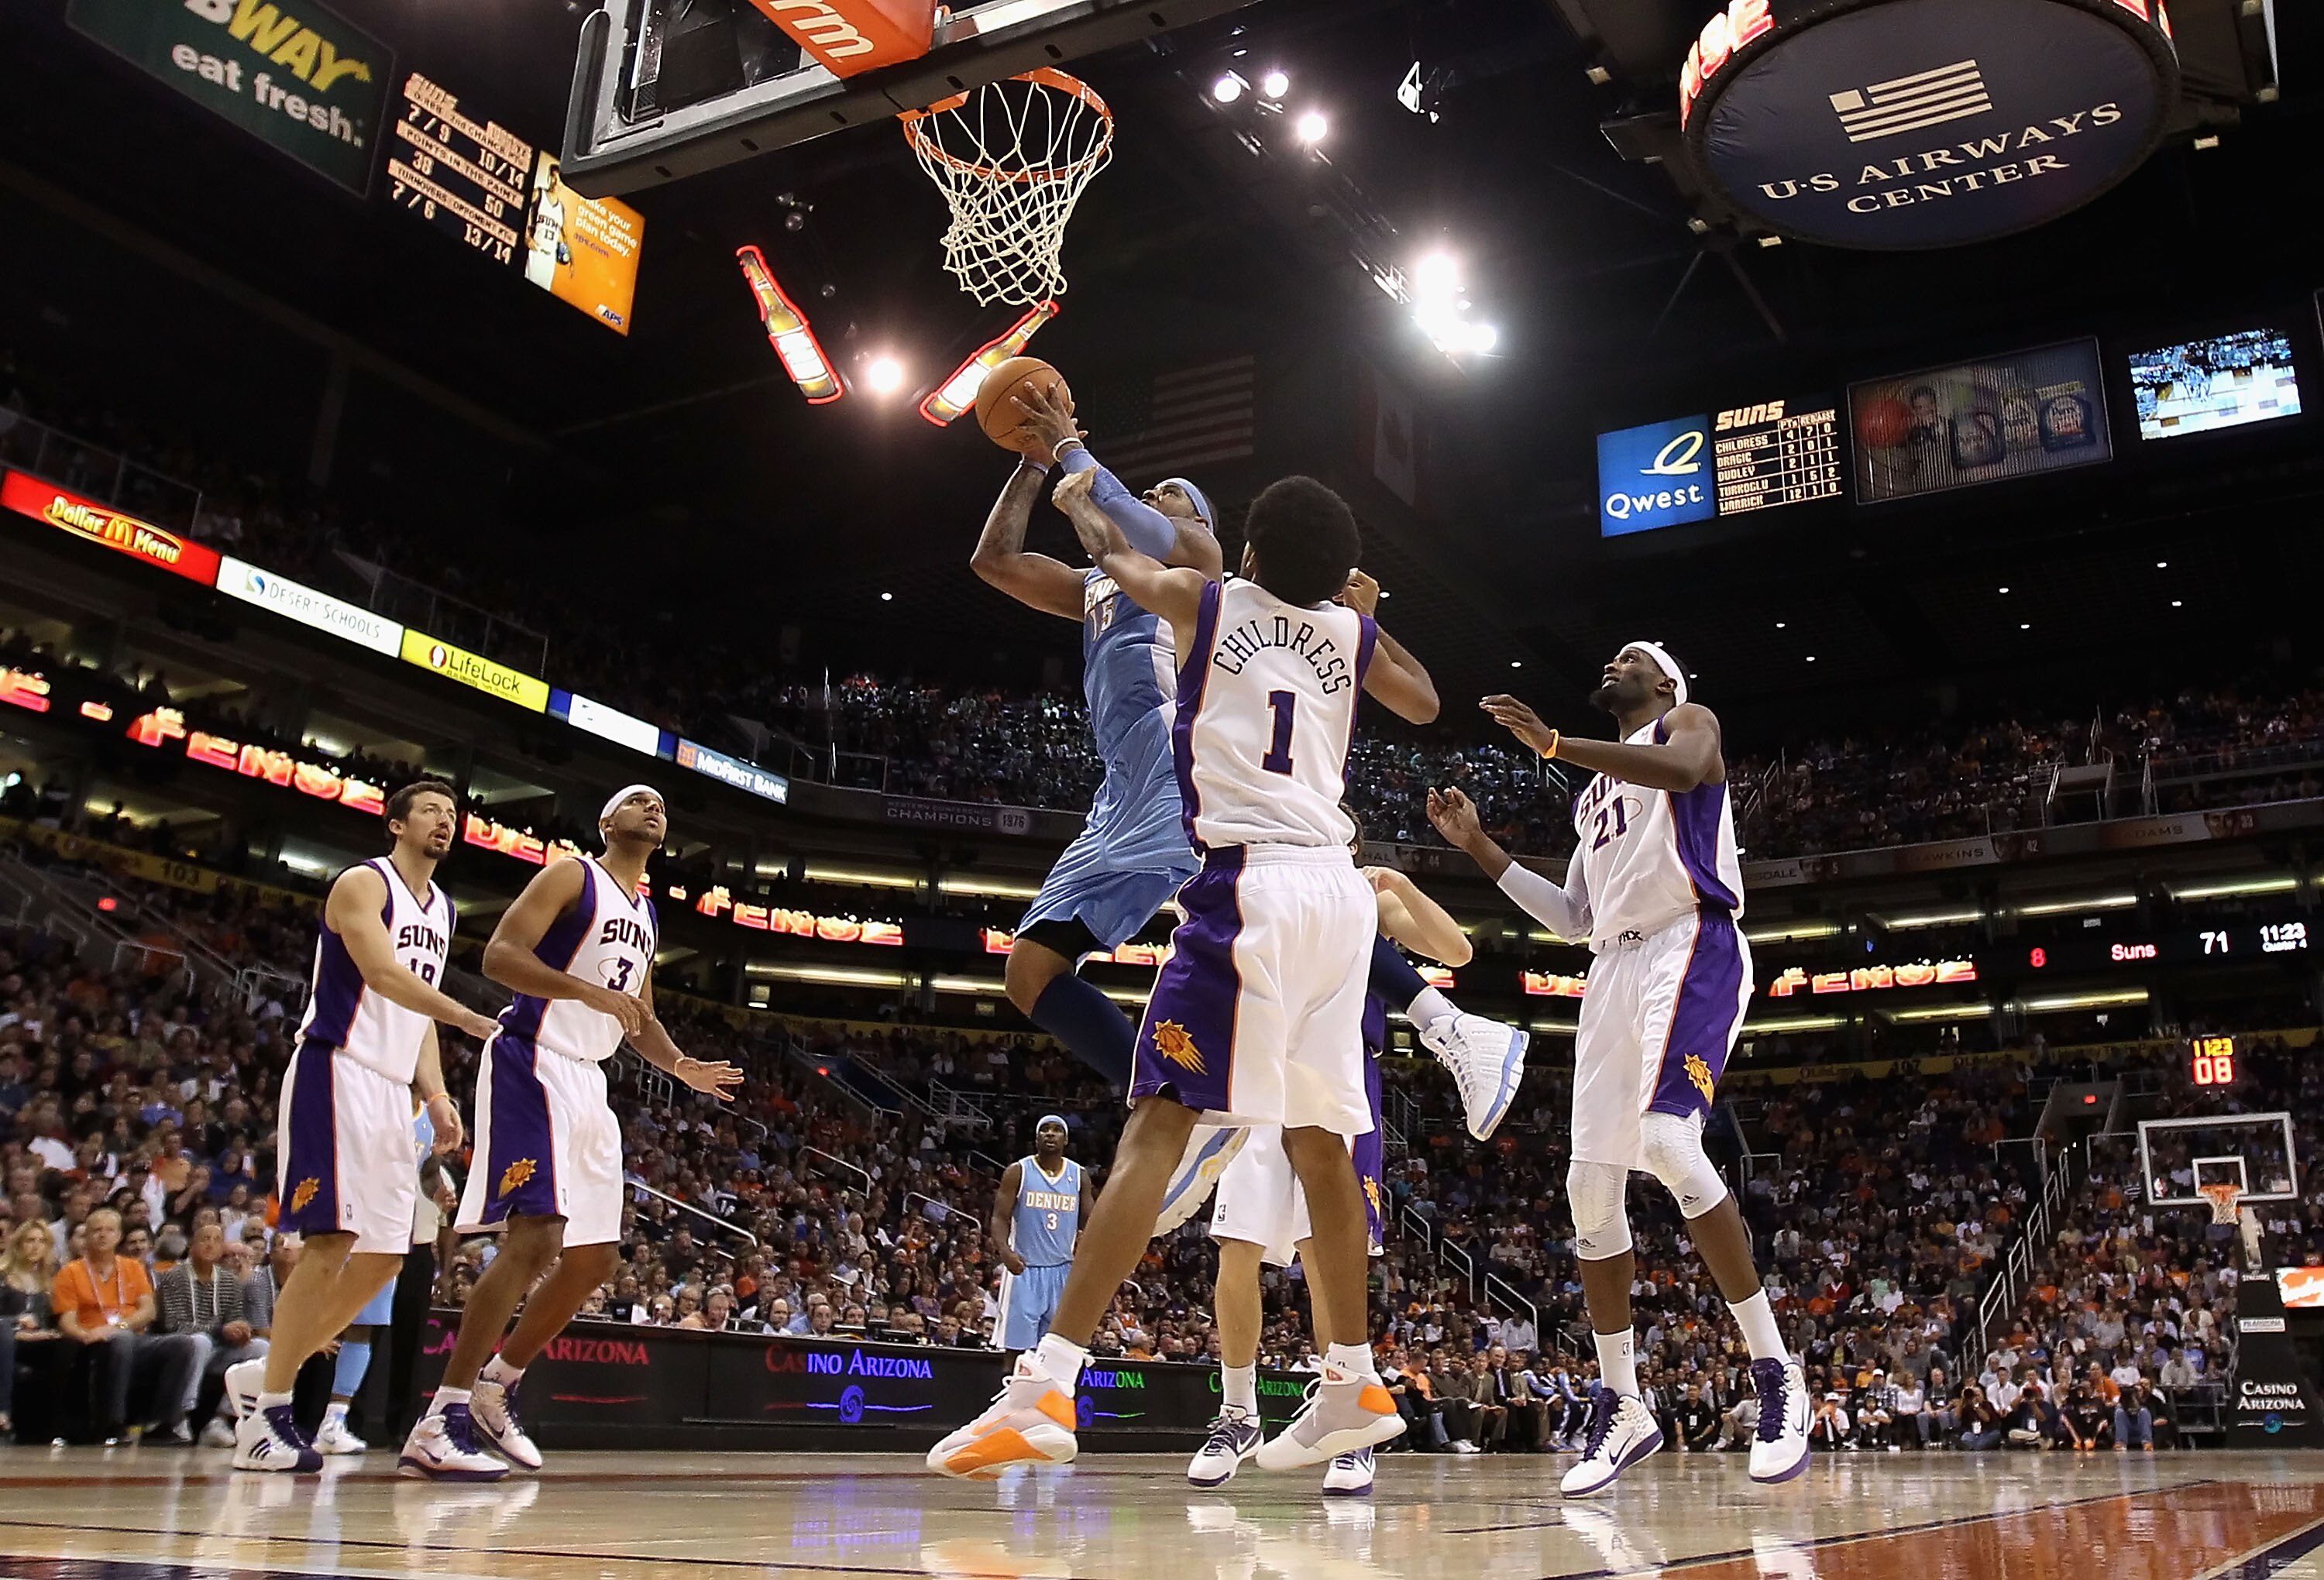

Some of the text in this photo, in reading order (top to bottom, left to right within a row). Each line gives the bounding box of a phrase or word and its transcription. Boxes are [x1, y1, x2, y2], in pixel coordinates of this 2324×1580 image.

[171, 43, 242, 93] eat
[1857, 102, 2123, 185] AIRWAYS
[406, 129, 517, 203] POINTS IN THE PAINT
[412, 149, 435, 176] 38
[397, 166, 448, 202] TURNOVERS
[1847, 153, 2071, 213] CENTER
[484, 193, 504, 218] 50
[575, 218, 600, 239] plan
[577, 204, 638, 249] green game
[608, 211, 632, 232] your
[602, 308, 624, 326] APS
[1715, 434, 1769, 454] CHILDRESS
[1716, 452, 1752, 468] DRAGIC
[1717, 465, 1755, 483] DUDLEY
[1719, 495, 1764, 513] WARRICK
[52, 496, 108, 534] Dollar
[133, 528, 180, 565] Menu
[269, 582, 380, 640] DESERT SCHOOLS
[1212, 616, 1352, 695] CHILDRESS
[449, 651, 521, 695] LifeLock
[1260, 689, 1298, 778] 1
[755, 775, 787, 802] BANK
[887, 807, 992, 827] CHAMPIONS
[1593, 795, 1628, 852] 21
[396, 925, 446, 962] SUNS
[2111, 943, 2157, 961] Suns
[2199, 931, 2229, 954] 71
[2260, 922, 2306, 943] 11:23
[2298, 938, 2308, 949] 4
[607, 956, 634, 991] 3
[2192, 1056, 2233, 1085] 08
[1026, 1191, 1077, 1212] DENVER
[1046, 1212, 1058, 1231] 3
[847, 1348, 933, 1379] ARIZONA
[1081, 1367, 1147, 1390] ARIZONA
[2240, 1379, 2298, 1396] CASINO
[2238, 1396, 2306, 1410] ARIZONA
